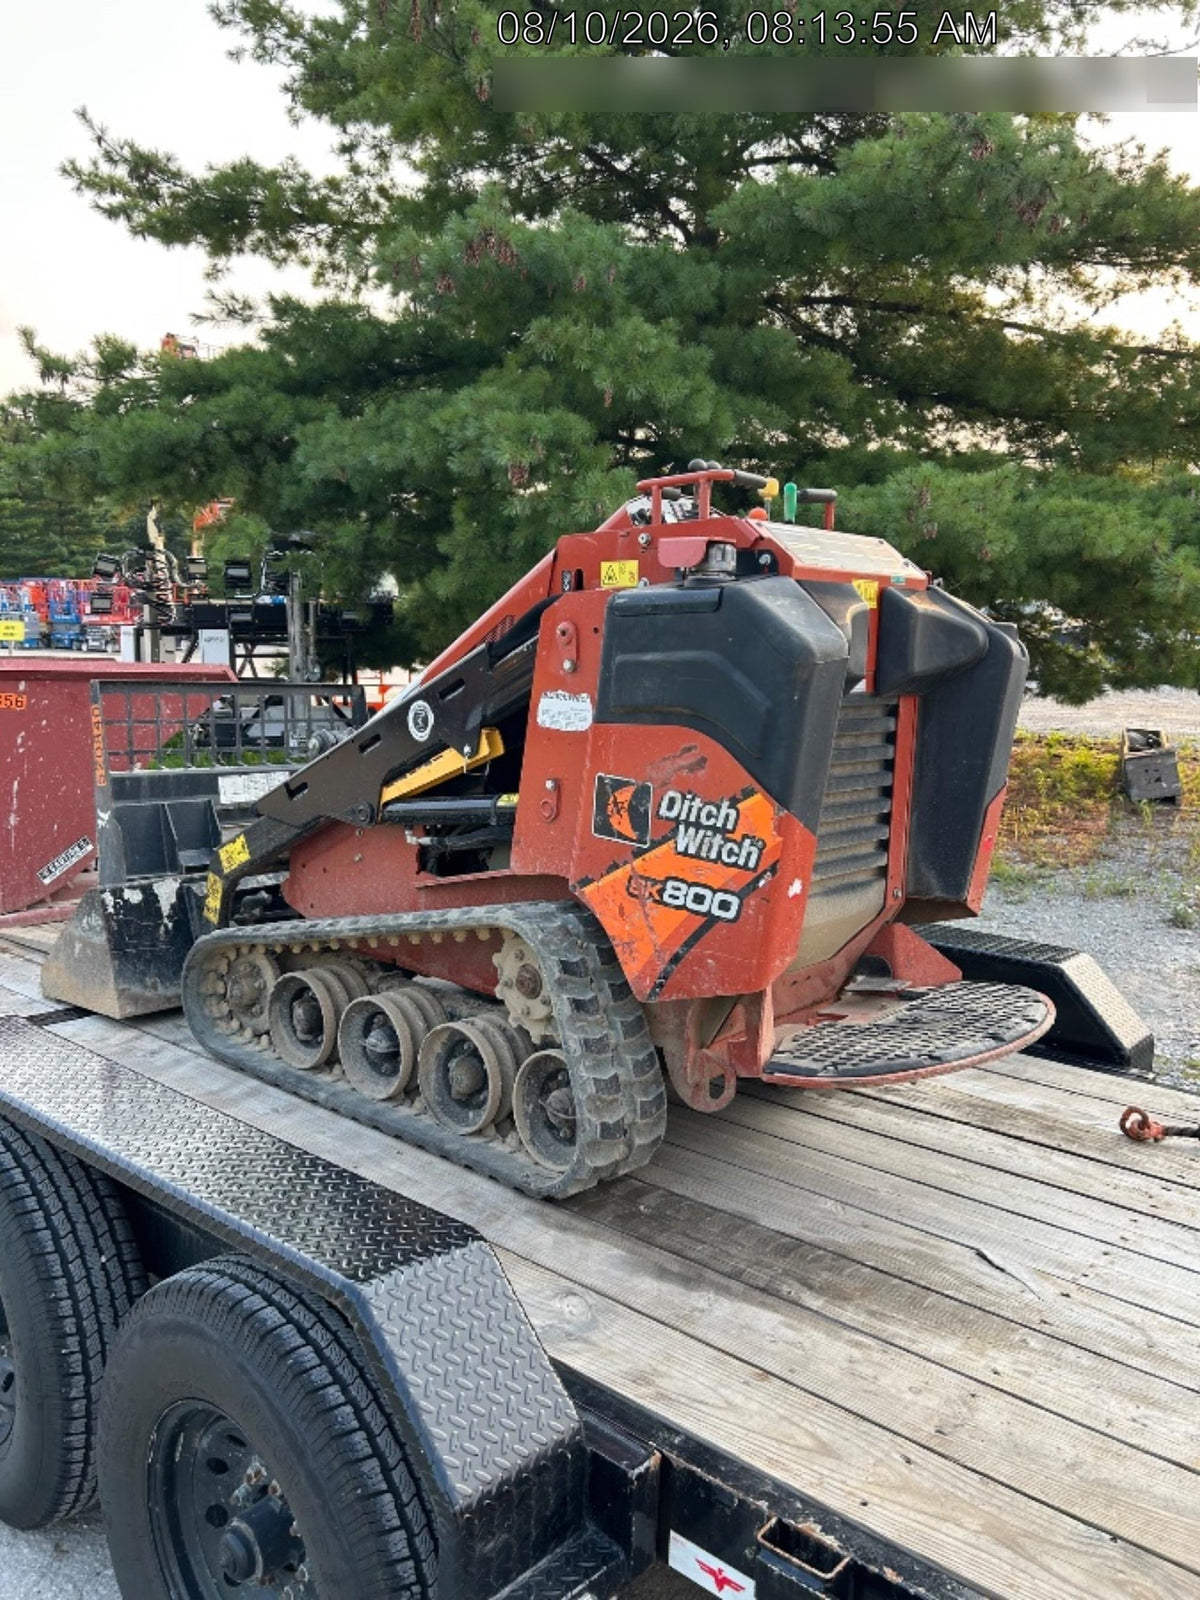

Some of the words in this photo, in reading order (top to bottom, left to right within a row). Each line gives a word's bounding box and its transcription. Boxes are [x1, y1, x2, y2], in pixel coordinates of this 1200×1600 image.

[0, 693, 24, 708] 56
[658, 789, 738, 831] Ditch
[676, 822, 762, 870] Witch
